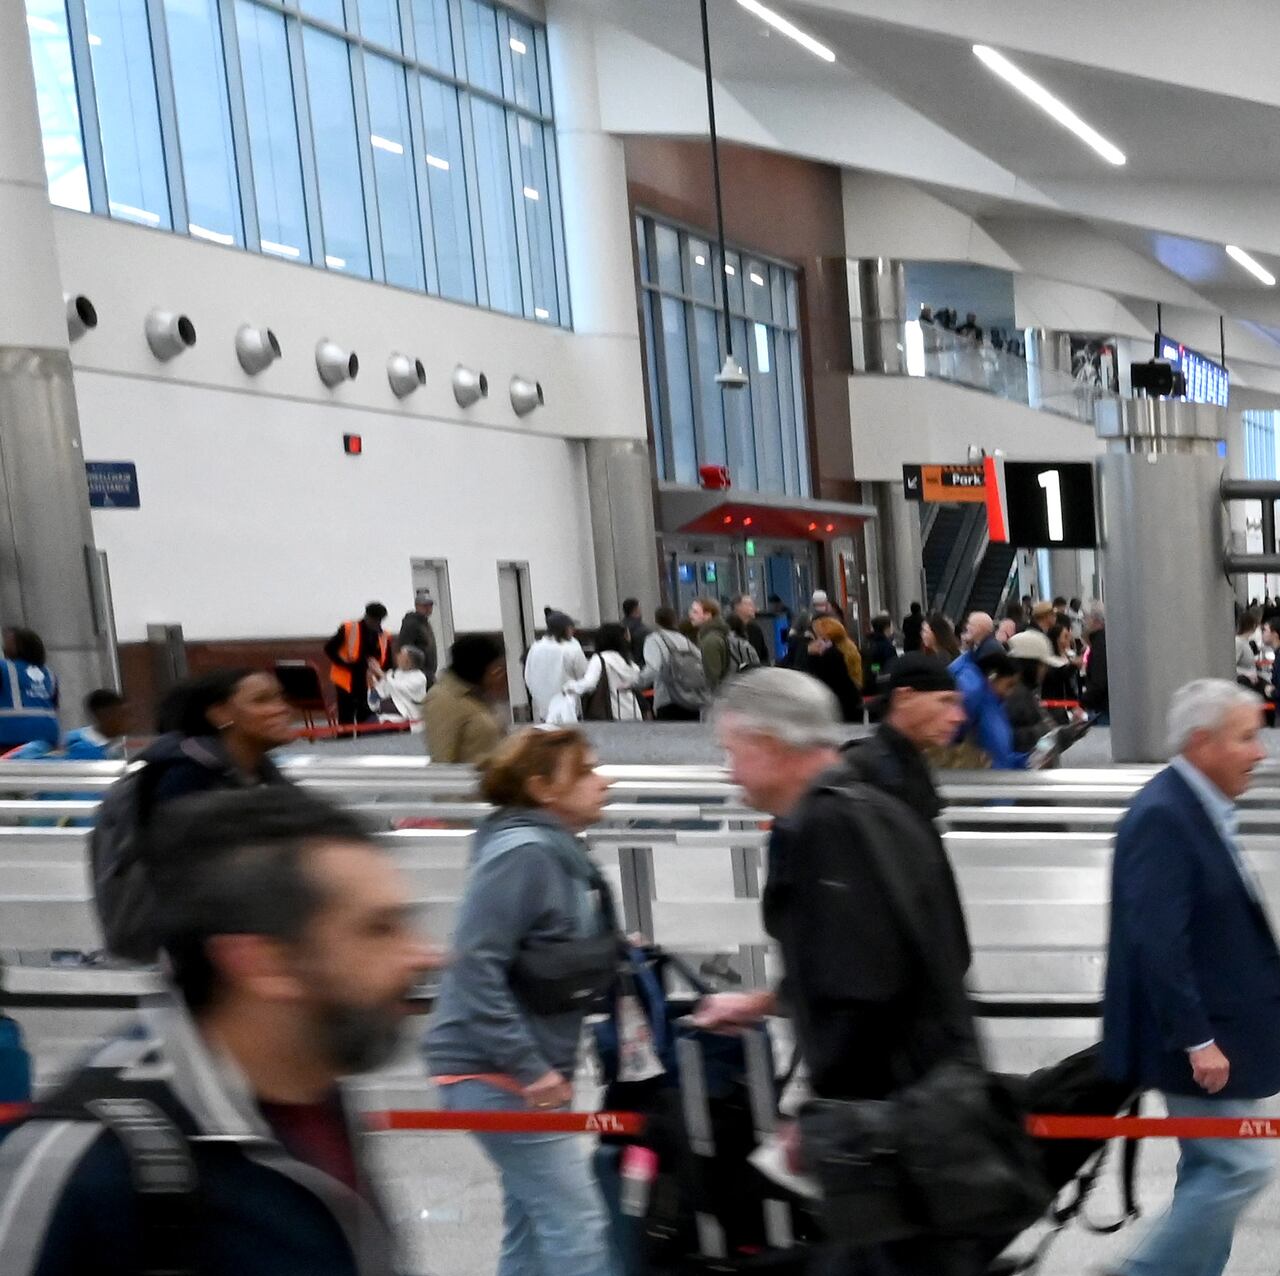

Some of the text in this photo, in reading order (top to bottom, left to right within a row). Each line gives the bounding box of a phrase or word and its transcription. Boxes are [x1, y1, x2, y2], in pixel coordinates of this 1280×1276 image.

[1037, 470, 1063, 541] 1
[585, 1114, 623, 1131] ATL
[1239, 1120, 1277, 1136] ATL
